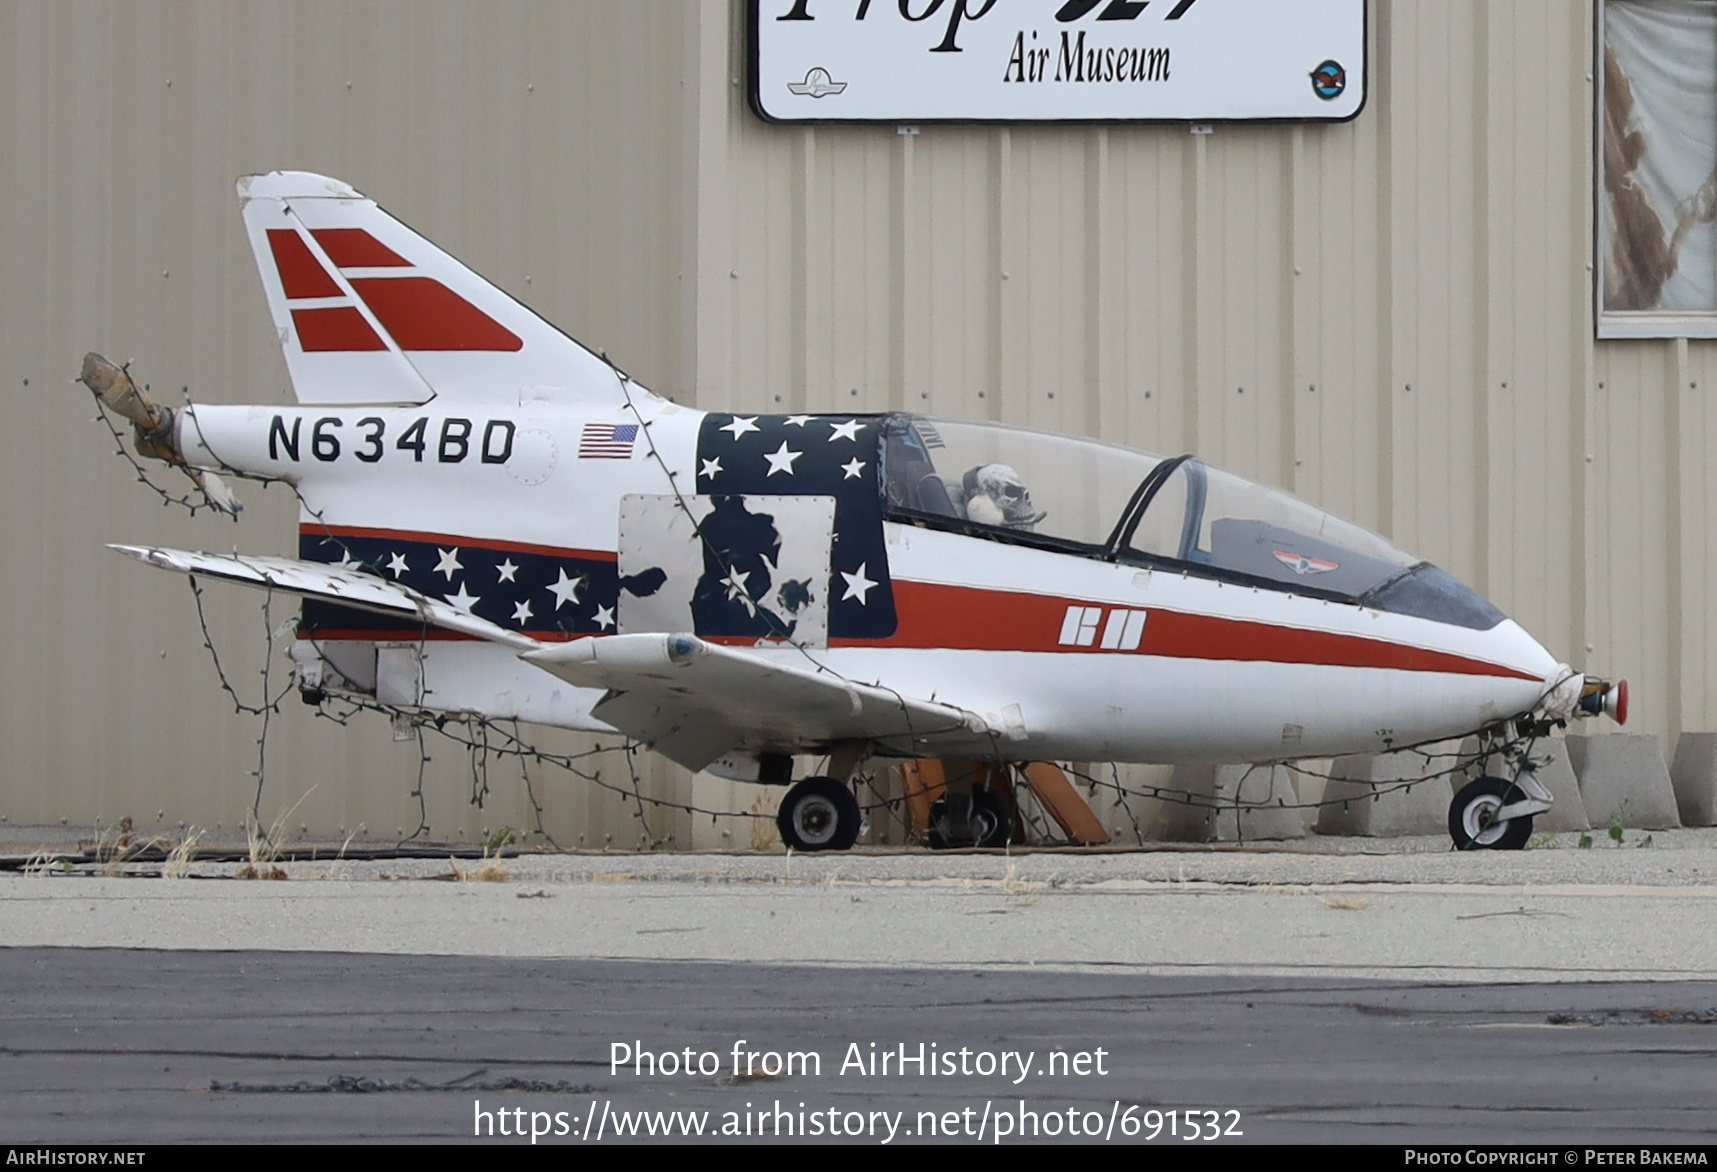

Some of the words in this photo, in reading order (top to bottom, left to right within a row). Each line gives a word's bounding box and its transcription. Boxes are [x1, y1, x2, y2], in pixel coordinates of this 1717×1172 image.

[1003, 30, 1049, 82] Air
[1054, 31, 1170, 82] Museum
[269, 415, 516, 464] N634BD
